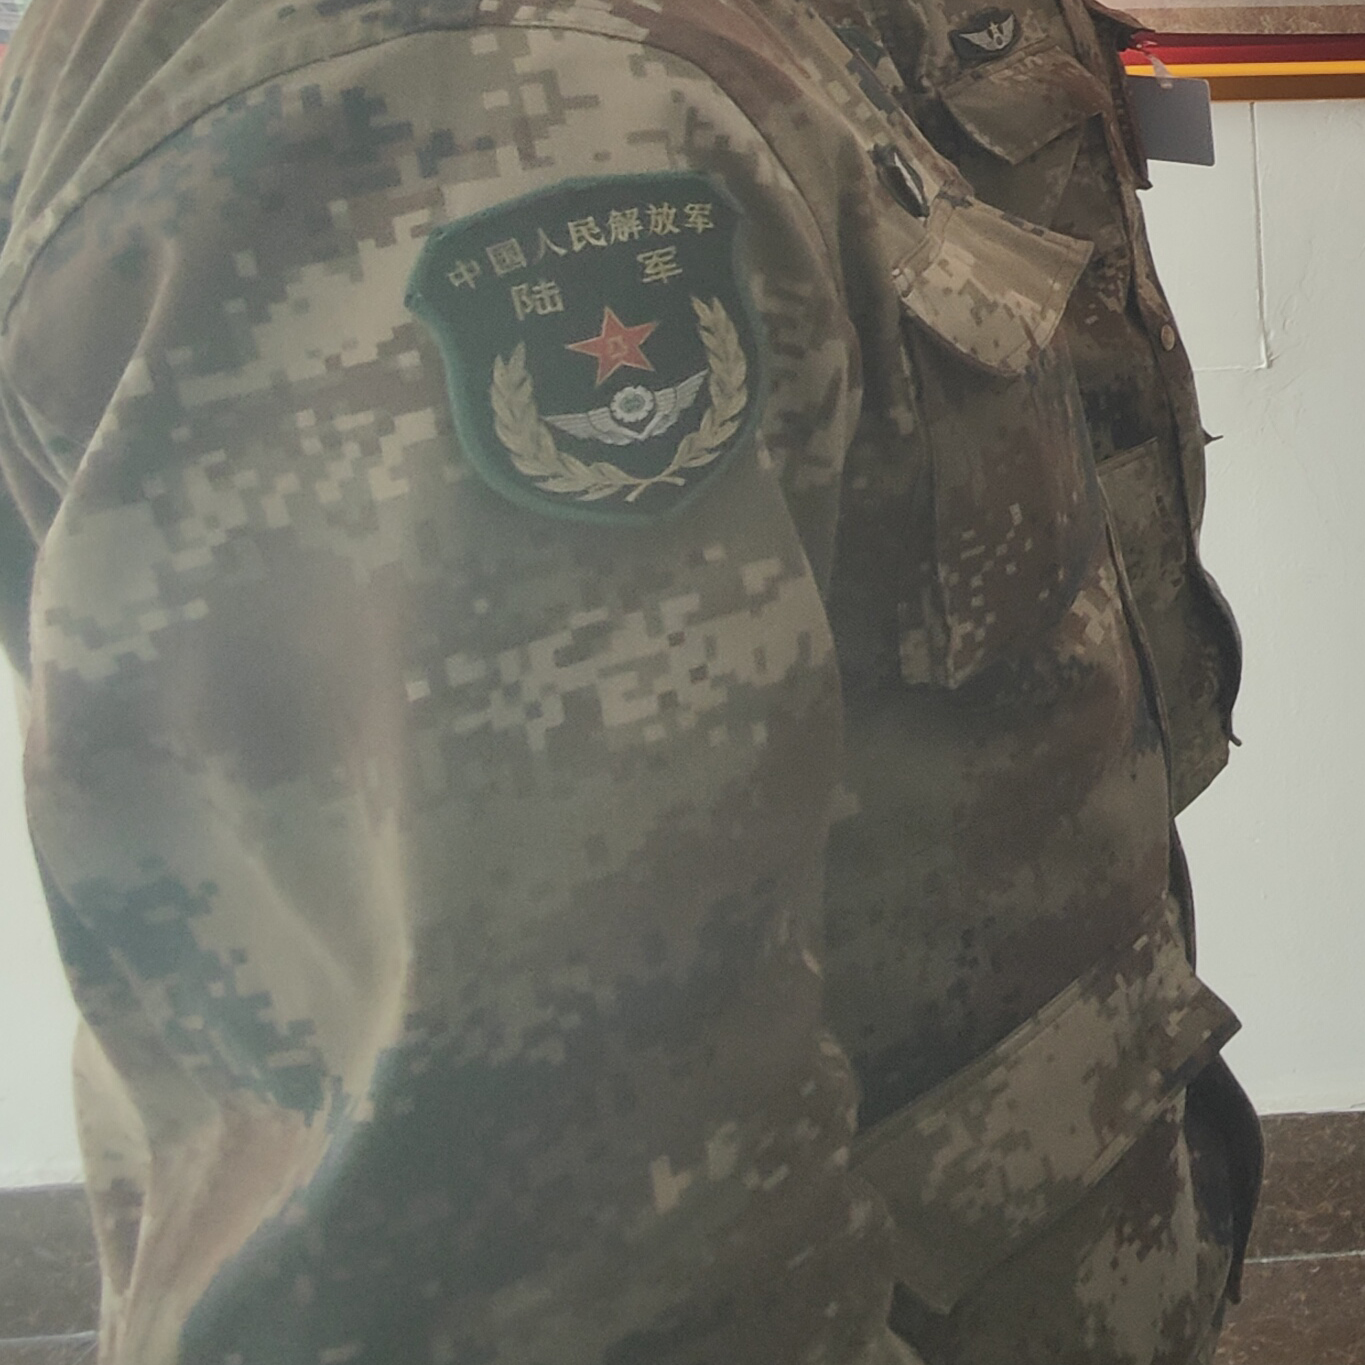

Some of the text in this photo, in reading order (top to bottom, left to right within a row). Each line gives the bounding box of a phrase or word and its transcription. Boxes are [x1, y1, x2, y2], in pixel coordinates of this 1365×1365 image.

[448, 202, 714, 290] 中国人民解放军
